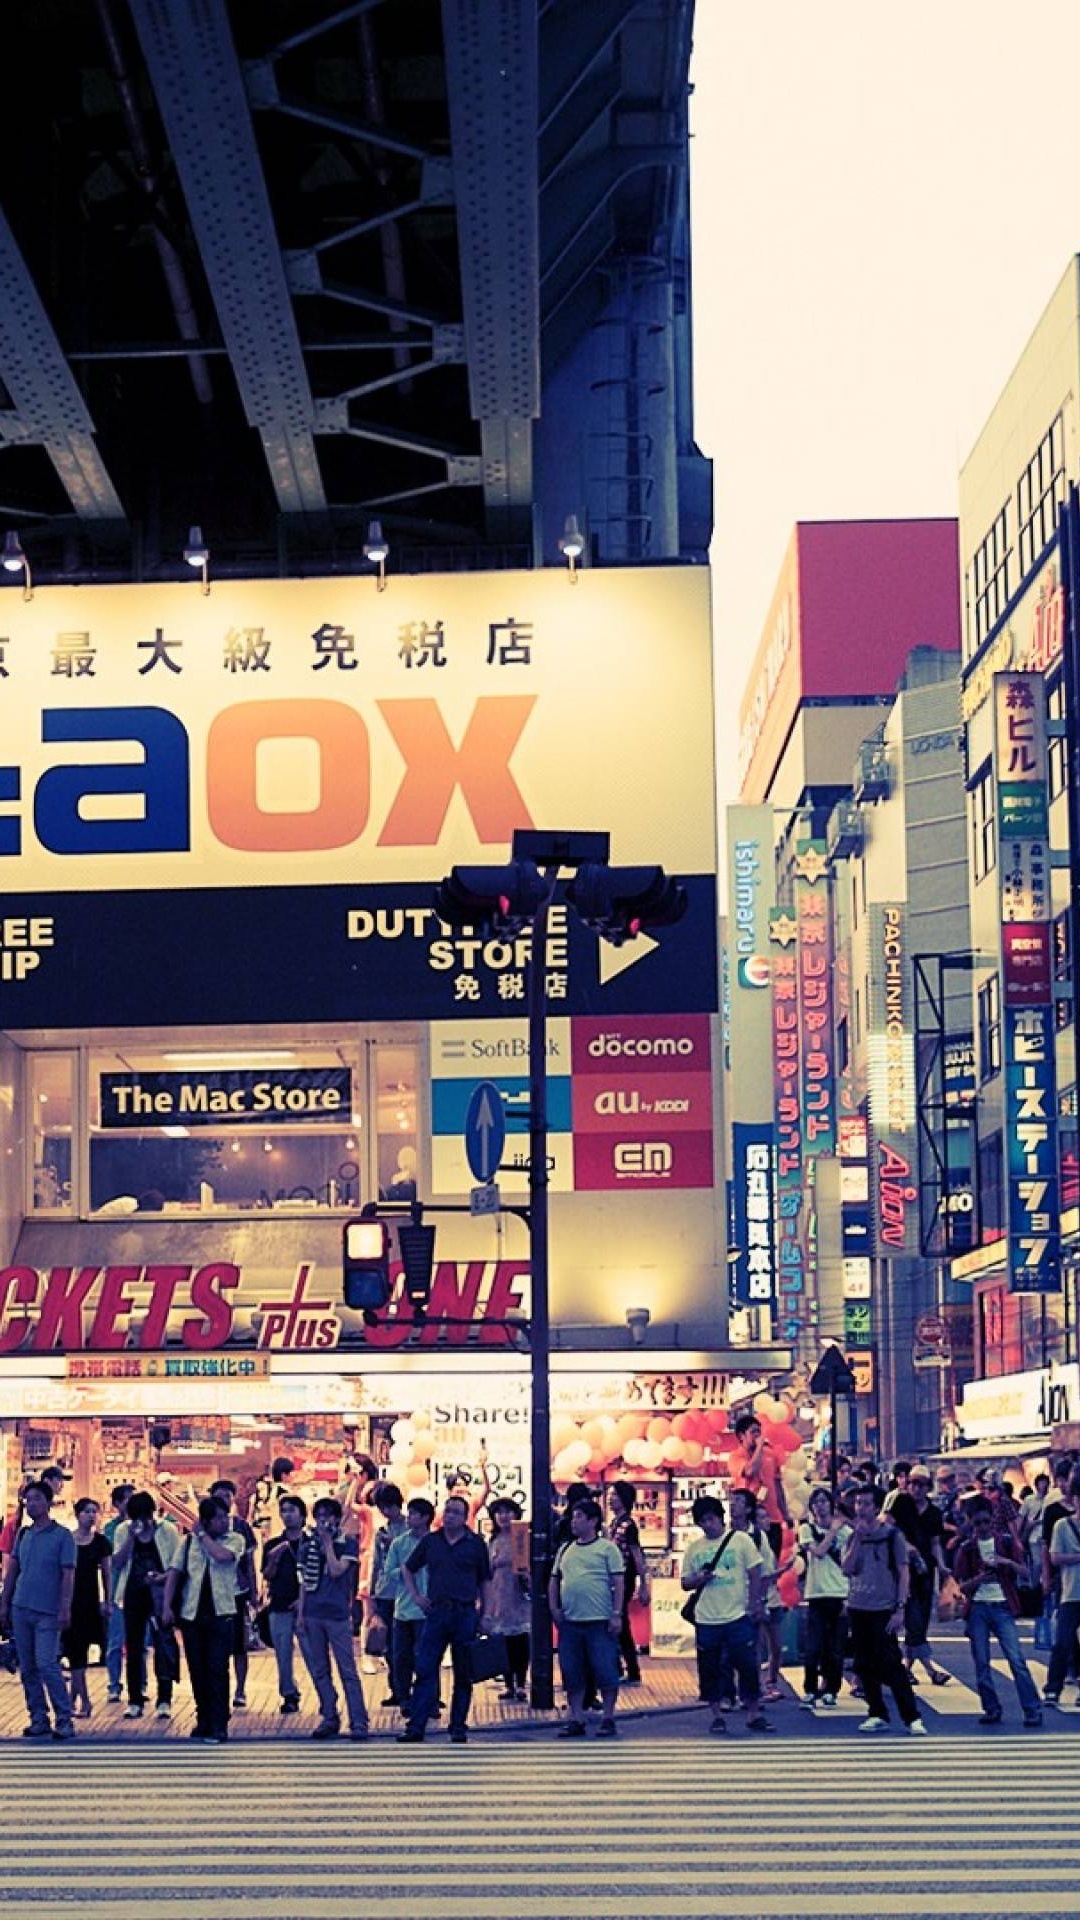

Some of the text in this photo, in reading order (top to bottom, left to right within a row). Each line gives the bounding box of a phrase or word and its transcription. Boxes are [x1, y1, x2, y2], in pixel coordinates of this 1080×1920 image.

[0, 617, 534, 678] 最大級免税店
[0, 694, 538, 856] aox
[734, 841, 760, 954] ishimaru
[454, 972, 568, 1000] 免税店
[883, 907, 904, 1038] PACHINKO
[471, 1038, 560, 1058] SoftBk
[588, 1034, 694, 1057] docomo
[112, 1082, 341, 1113] The Mac Store
[594, 1091, 639, 1115] au
[434, 1404, 529, 1424] Share!
